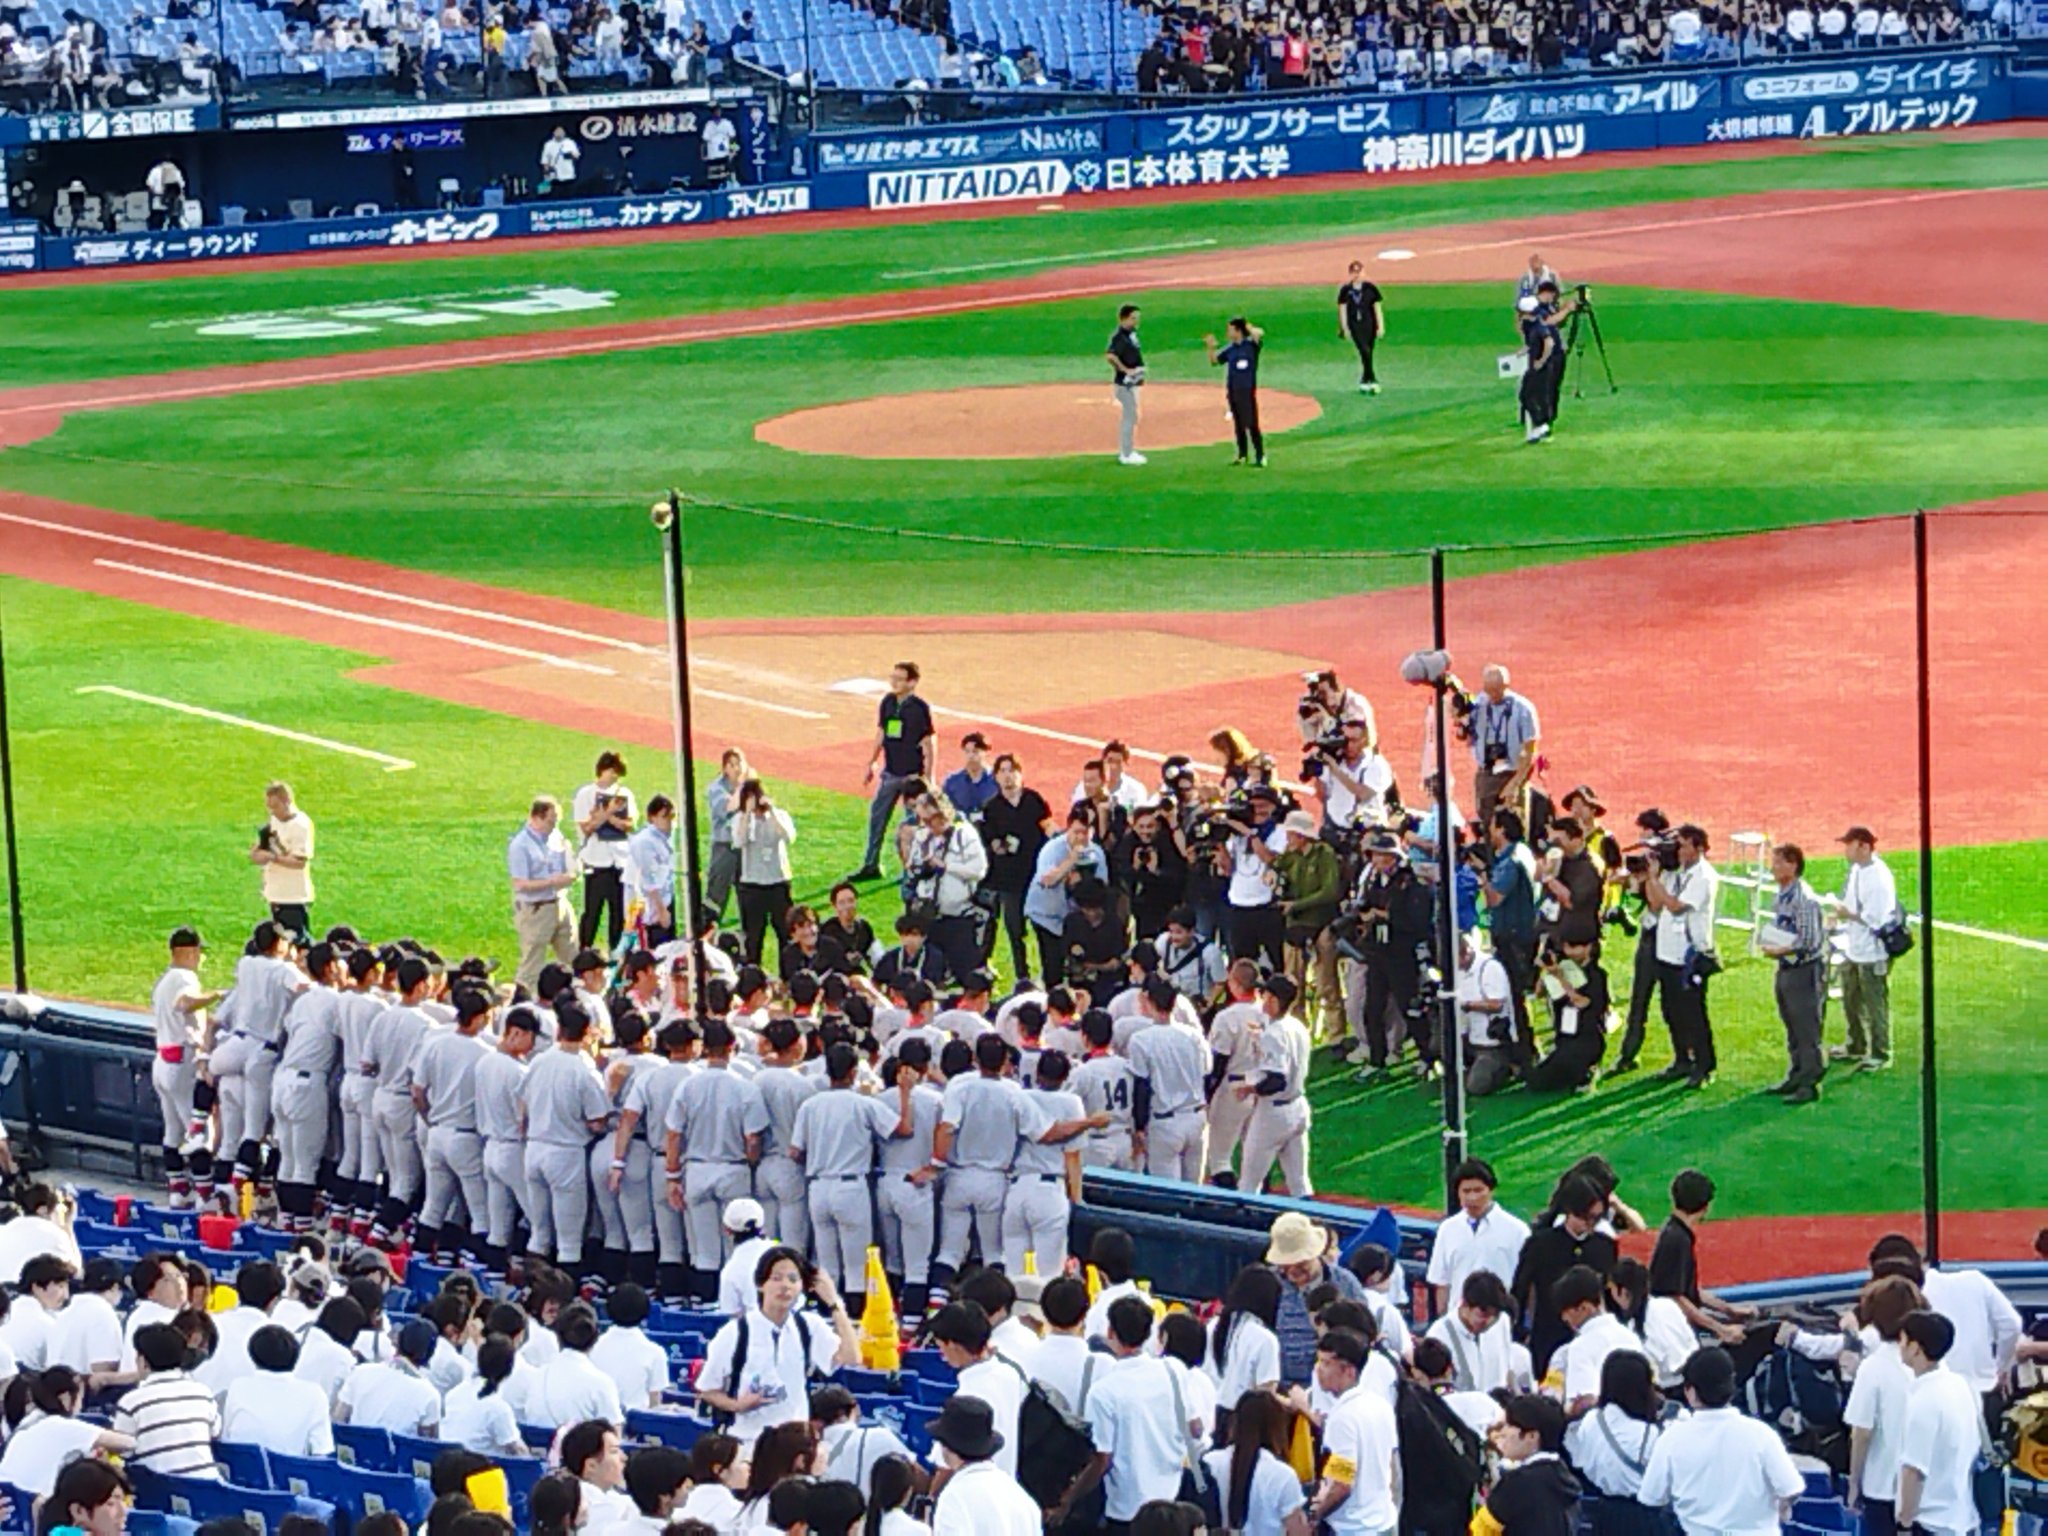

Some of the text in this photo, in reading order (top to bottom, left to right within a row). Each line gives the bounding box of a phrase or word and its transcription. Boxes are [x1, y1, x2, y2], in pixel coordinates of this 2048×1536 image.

[1865, 58, 1978, 95] ダイイチ
[1612, 80, 1700, 115] アイル
[1842, 93, 1979, 135] アルテック
[110, 108, 196, 137] 全国保証
[616, 111, 698, 137] 清水建設
[1020, 125, 1100, 152] Navita
[1166, 102, 1391, 146] スタッフサービス
[1363, 123, 1585, 173] 神奈川ダイハツ
[1106, 145, 1291, 190] 日本体育大学
[875, 166, 1057, 205] NITTAIDAI
[389, 212, 500, 245] オービック
[619, 200, 703, 226] カナデン
[131, 231, 258, 261] ディーラウンド
[1102, 1077, 1129, 1111] 14
